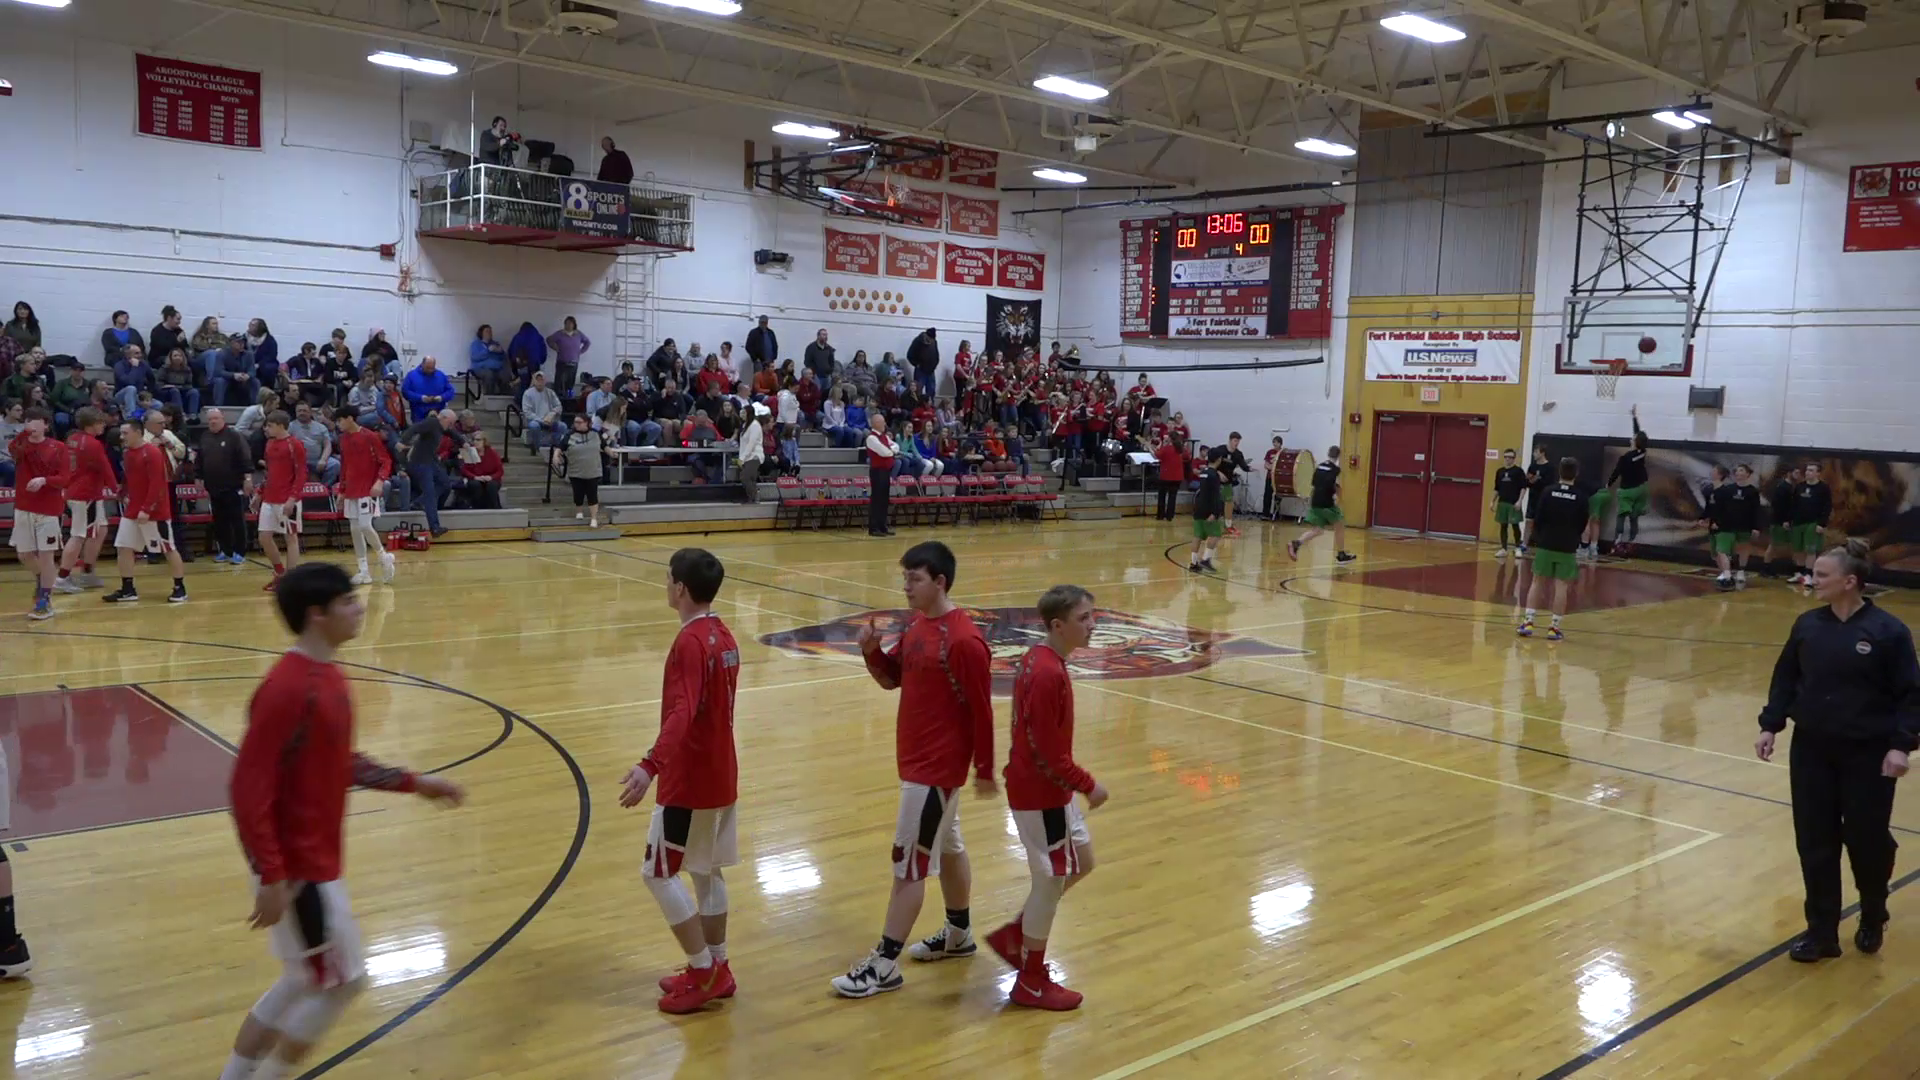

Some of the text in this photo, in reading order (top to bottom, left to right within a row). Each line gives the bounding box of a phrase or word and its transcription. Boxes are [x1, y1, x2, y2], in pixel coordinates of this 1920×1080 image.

[145, 72, 254, 96] VOLLEYBALL CHAMPIONS
[155, 66, 244, 86] AROOSTOOK LEAGUE
[160, 87, 184, 95] GIRLS
[1899, 180, 1920, 191] 10
[567, 183, 624, 212] 8 SPORTS
[572, 220, 618, 230] WAGMTV.COM
[1207, 213, 1243, 234] 13:06
[1178, 229, 1196, 248] 00
[1250, 224, 1269, 244] 00
[828, 234, 877, 257] STATE CHAMPIONS
[888, 241, 936, 258] STATE CHAMPIONS
[1210, 243, 1243, 256] period 4
[946, 249, 992, 266] STATE CHAMPIONS
[999, 254, 1043, 271] STATE CHAMPIONS
[1369, 330, 1520, 342] Fort Fairfield Middle High School
[1424, 391, 1437, 399] EXIT
[1552, 491, 1576, 500] DELISLE
